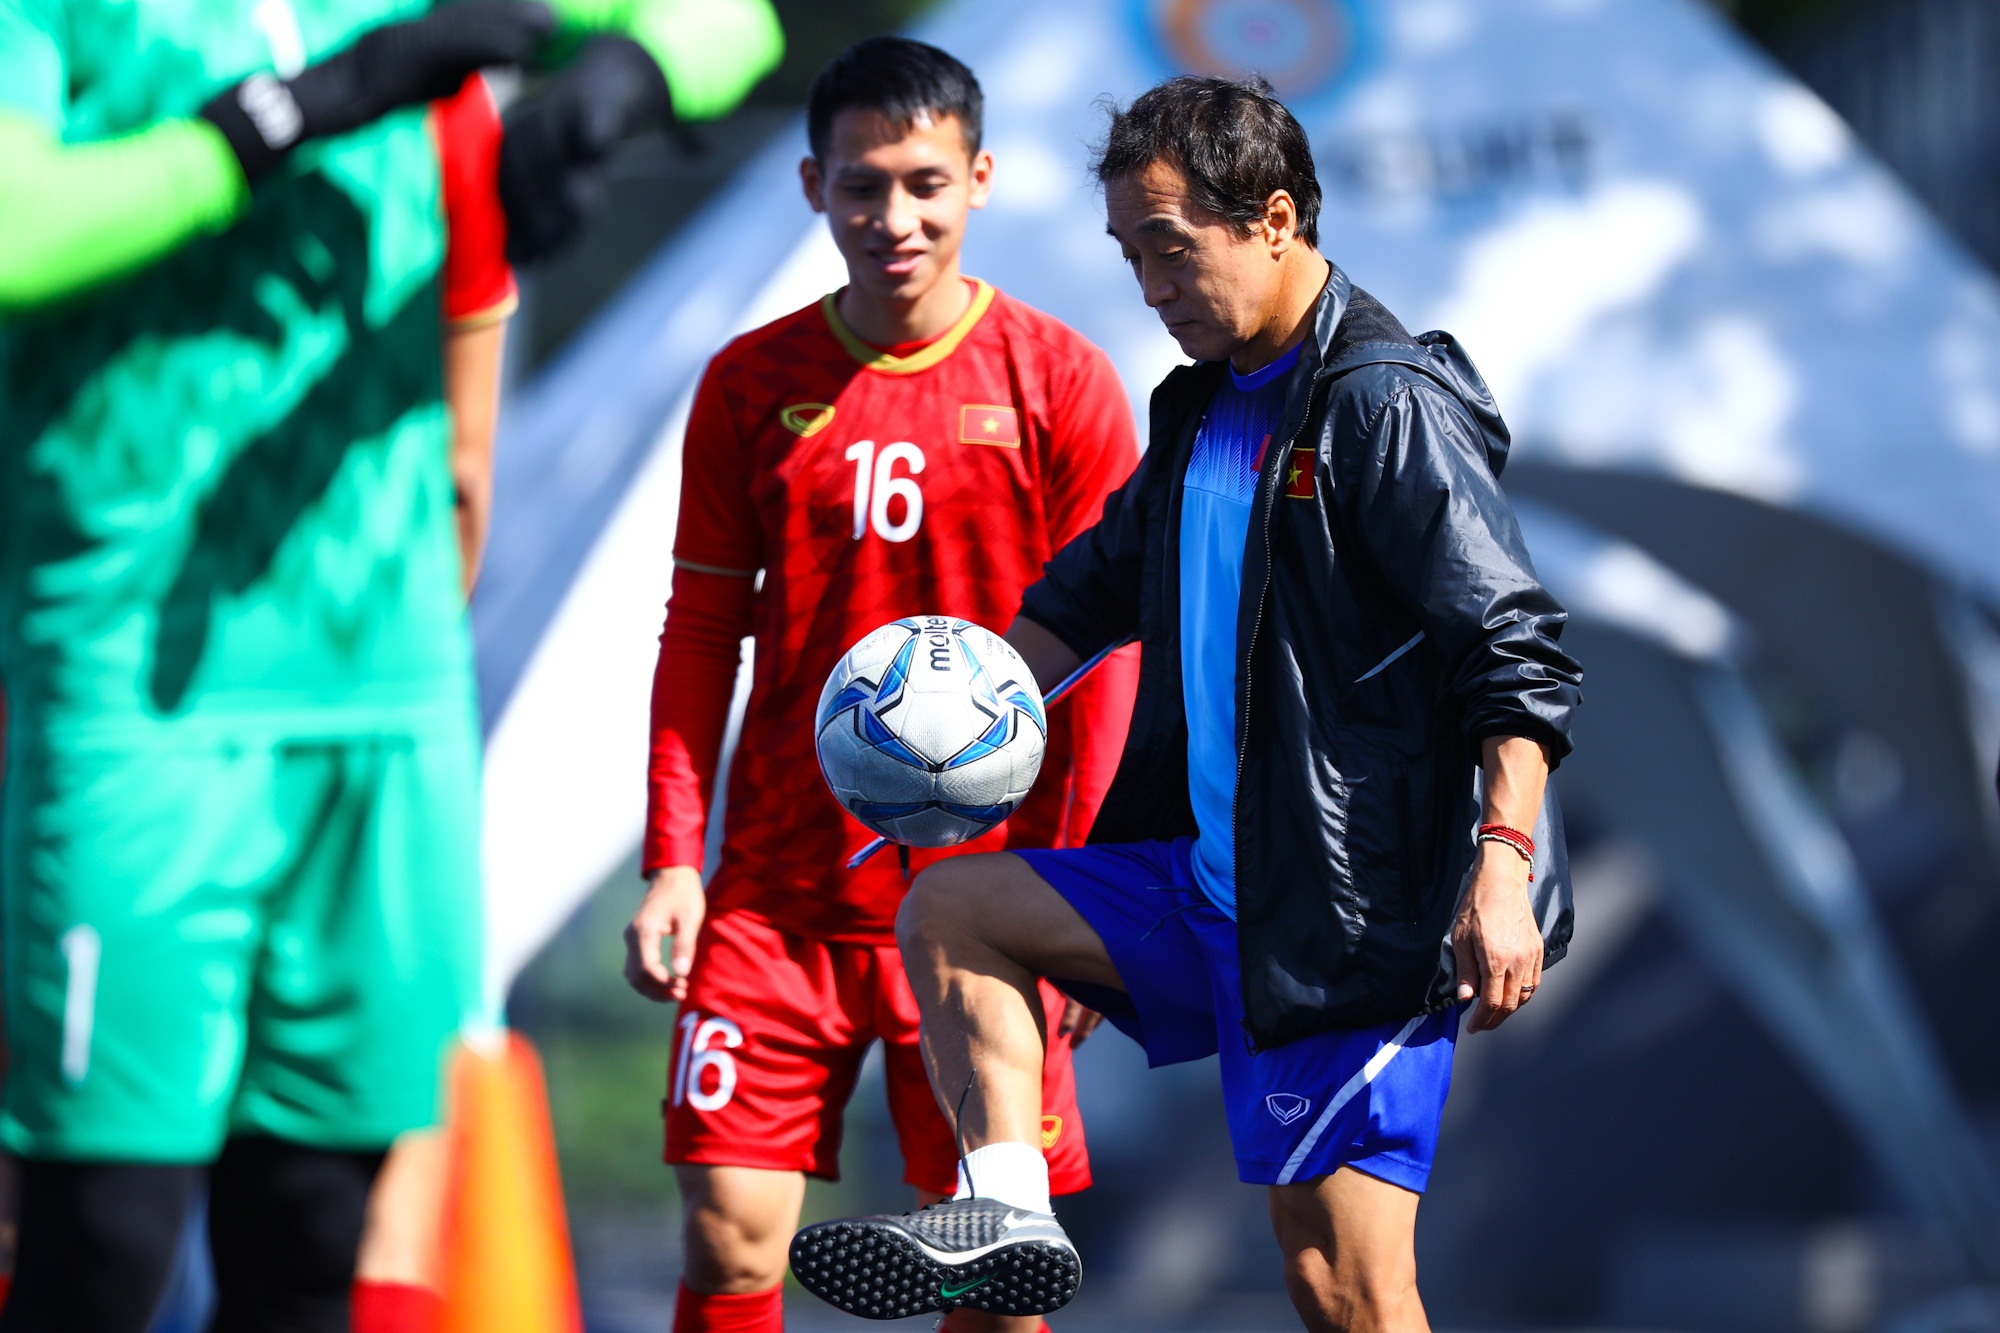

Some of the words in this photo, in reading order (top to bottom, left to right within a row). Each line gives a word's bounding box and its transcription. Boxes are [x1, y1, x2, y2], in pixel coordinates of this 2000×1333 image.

[845, 440, 926, 543] 16
[924, 615, 951, 672] molte
[60, 922, 102, 1083] 1
[672, 1010, 744, 1112] 16
